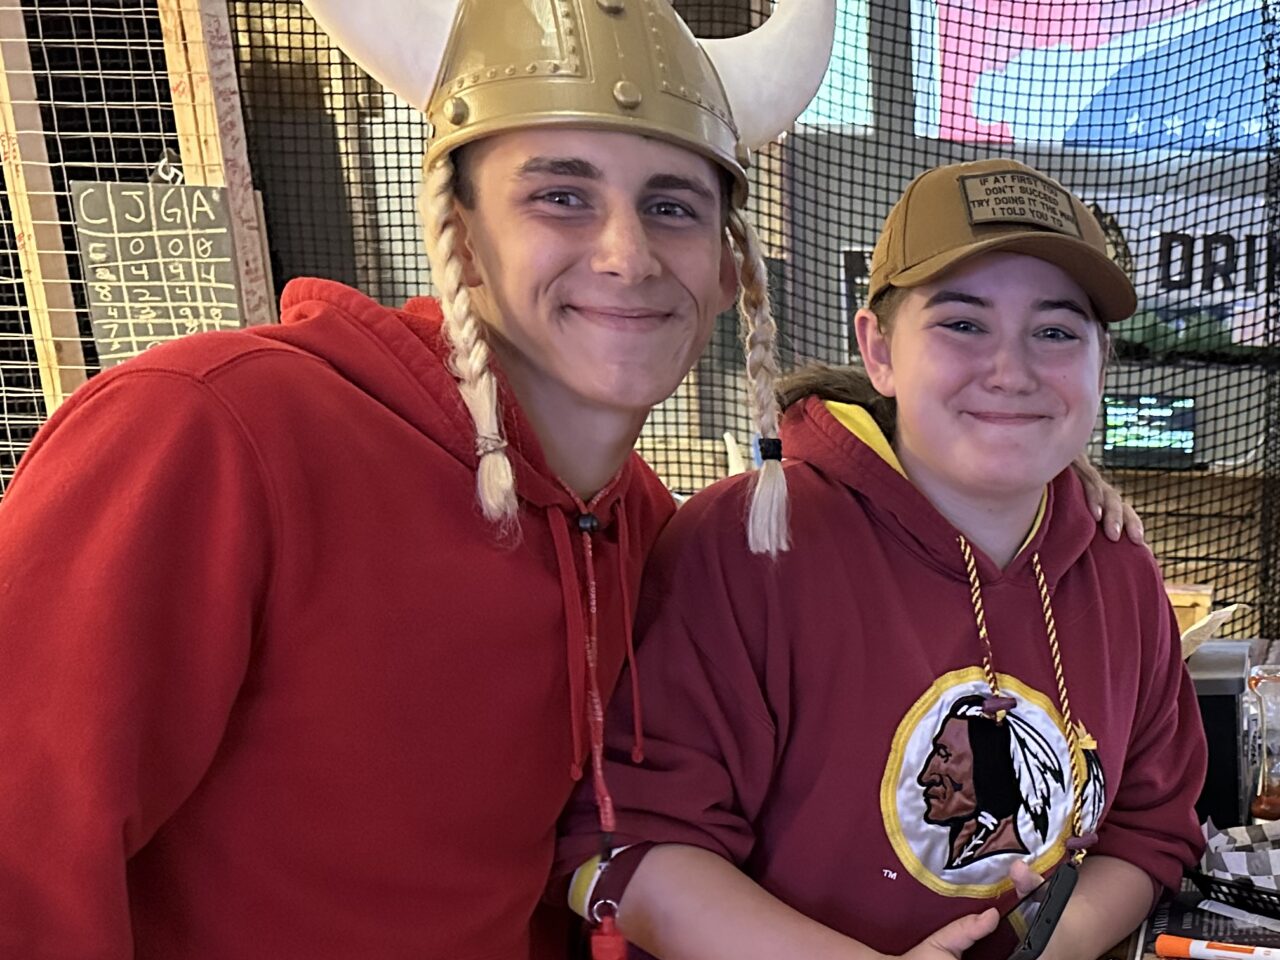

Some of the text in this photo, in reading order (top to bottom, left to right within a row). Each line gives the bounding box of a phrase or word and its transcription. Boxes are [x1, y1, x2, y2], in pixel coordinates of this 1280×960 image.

[980, 177, 989, 186] IF
[993, 175, 1007, 185] AT
[1011, 175, 1039, 187] FIRST
[970, 199, 991, 209] TRY
[995, 195, 1026, 206] DOING
[1028, 197, 1038, 207] IT
[1039, 202, 1059, 215] THE
[985, 185, 1059, 206] DON'T SUCCEED
[79, 188, 109, 224] C
[191, 189, 216, 223] A
[1000, 207, 1026, 216] TOLD
[1030, 208, 1049, 221] YOU
[1050, 215, 1064, 227] TO
[882, 869, 898, 880] TM
